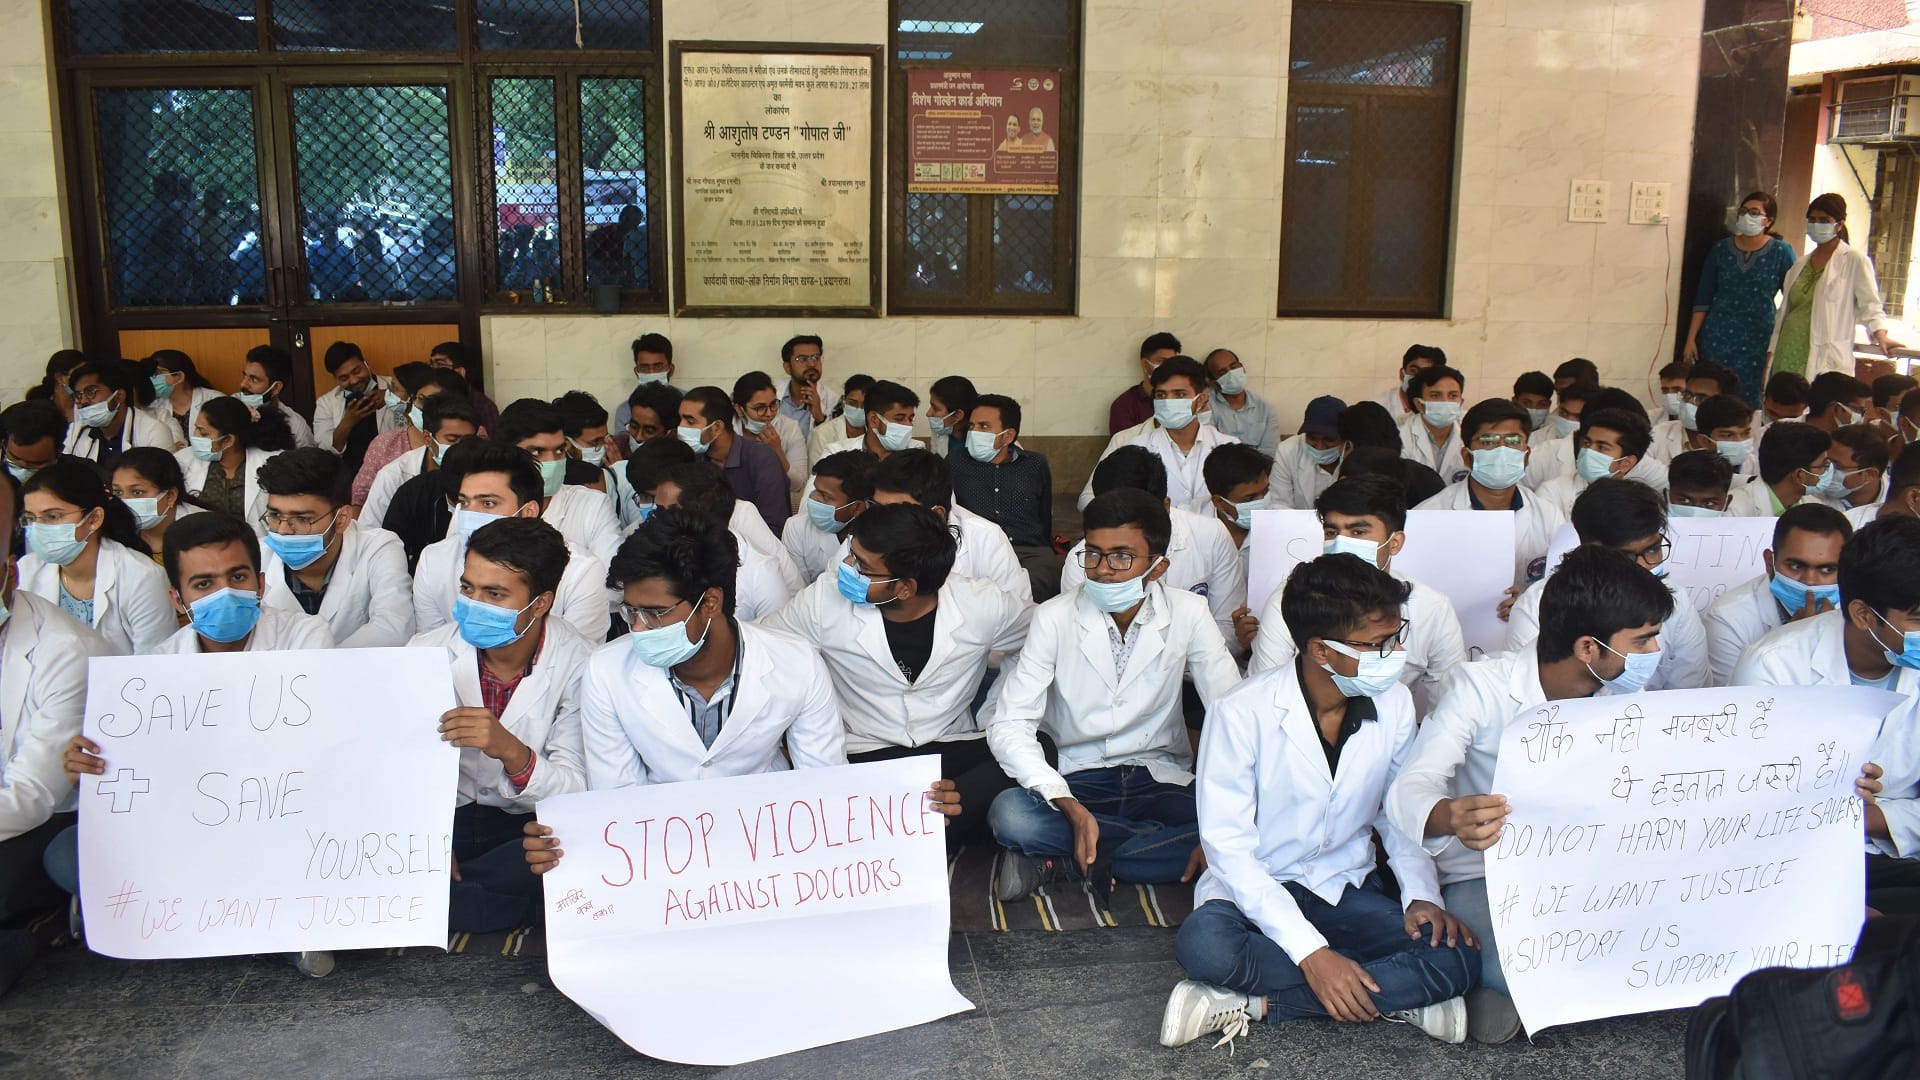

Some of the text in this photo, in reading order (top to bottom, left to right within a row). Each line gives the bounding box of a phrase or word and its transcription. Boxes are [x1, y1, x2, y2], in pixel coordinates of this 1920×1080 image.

[765, 104, 790, 115] लोकार्पण
[912, 92, 931, 106] विशेष
[958, 92, 974, 106] कार्ड
[976, 92, 1003, 107] अभियान
[704, 120, 715, 140] श्री
[719, 122, 758, 146] आशुतोष
[762, 126, 790, 140] टण्डन
[99, 674, 312, 738] SAVE US
[1662, 703, 1738, 742] मजबूरी
[192, 771, 304, 826] SAVE
[601, 790, 935, 887] STOP VIOLENCE
[1537, 824, 1607, 858] NOT
[1616, 817, 1687, 856] HARM
[1698, 813, 1751, 852] YOUR
[665, 858, 902, 925] AGAINST DOCTORS
[1582, 879, 1666, 912] WANT
[1680, 858, 1799, 902] JUSTICE
[199, 897, 283, 932] WANT
[296, 896, 424, 940] JUSTICE
[1640, 924, 1680, 952] US
[1626, 950, 1738, 988] SUPPORT
